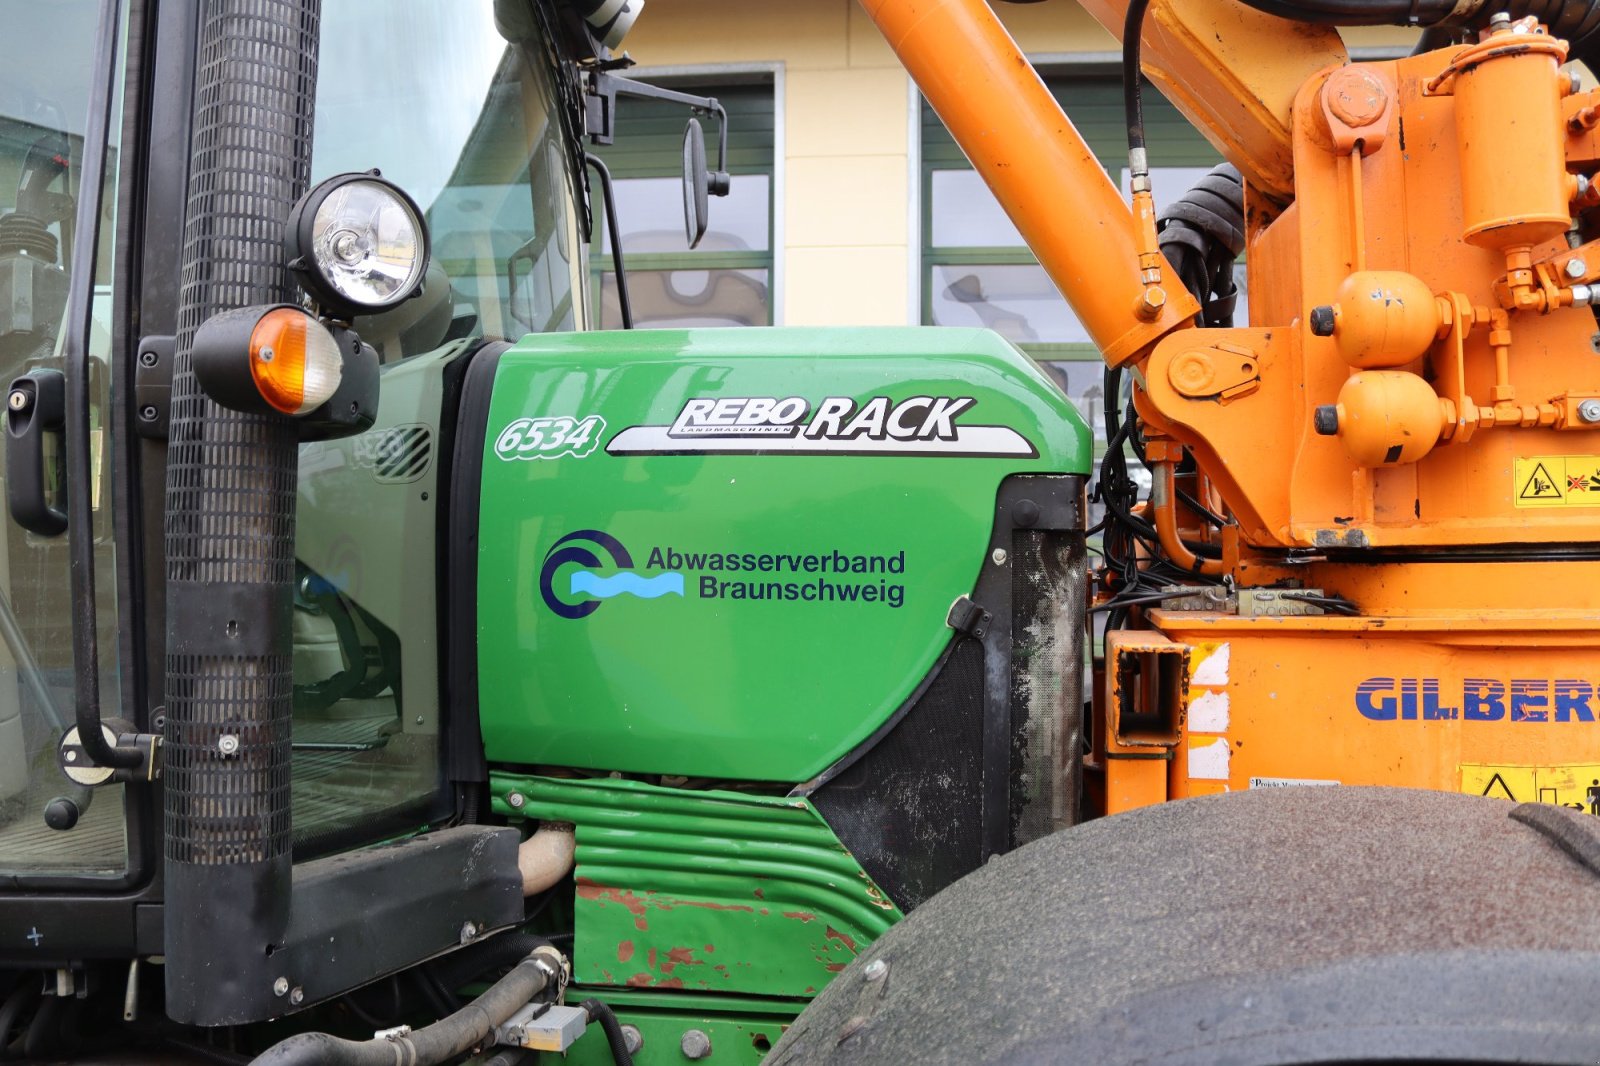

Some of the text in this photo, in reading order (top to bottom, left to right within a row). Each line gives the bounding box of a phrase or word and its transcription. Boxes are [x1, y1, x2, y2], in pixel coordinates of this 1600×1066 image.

[669, 396, 975, 439] REBO RACK
[497, 418, 598, 452] 6534
[646, 546, 905, 574] Abwasserverband
[699, 575, 905, 608] Braunschweig
[1355, 677, 1600, 722] GILBER
